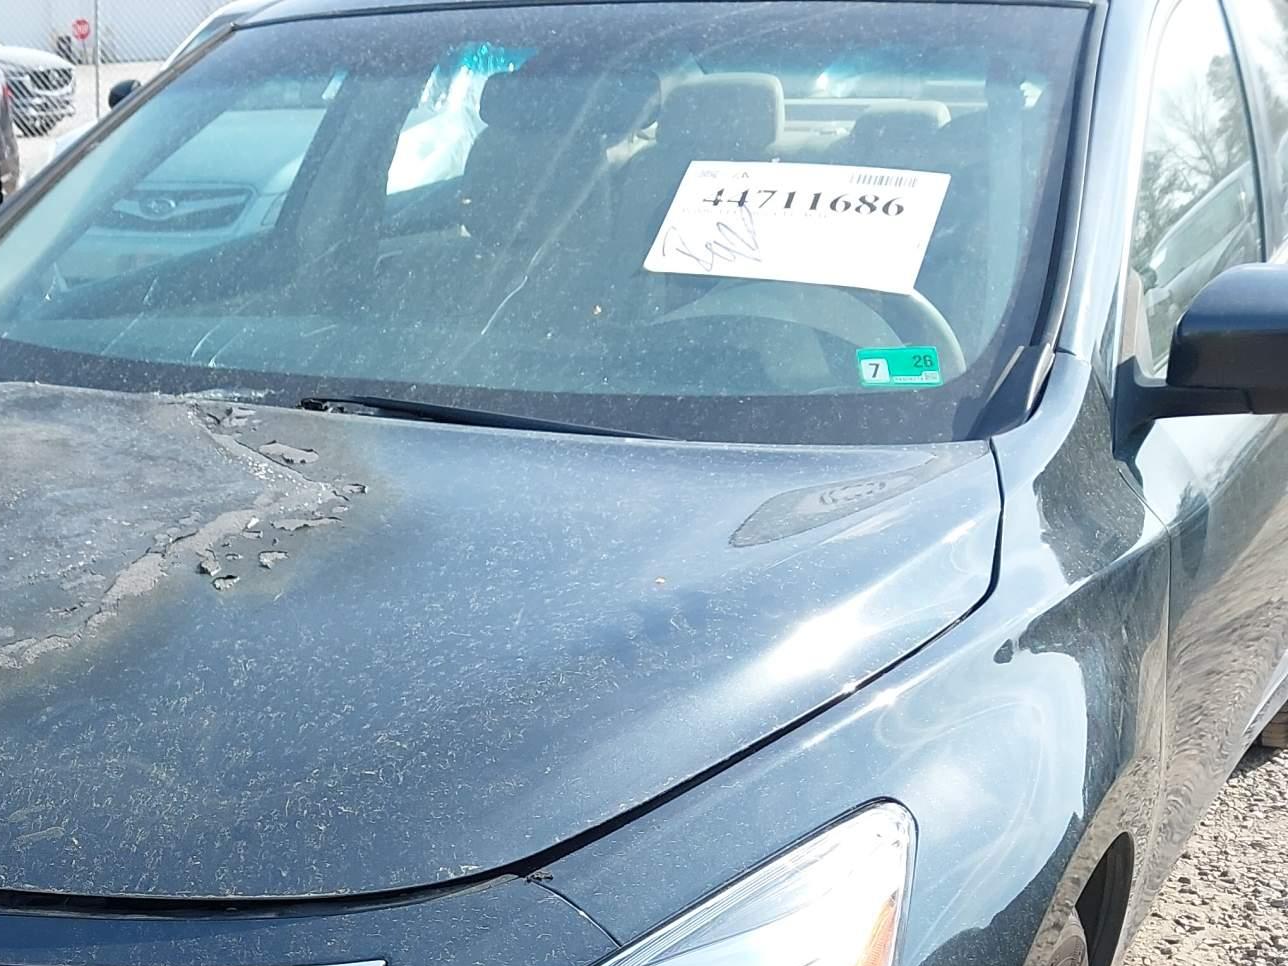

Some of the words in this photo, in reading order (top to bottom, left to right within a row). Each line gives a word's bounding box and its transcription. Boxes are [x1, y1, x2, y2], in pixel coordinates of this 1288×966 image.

[701, 187, 905, 217] 44711686
[912, 354, 934, 368] 26
[868, 362, 880, 379] 7
